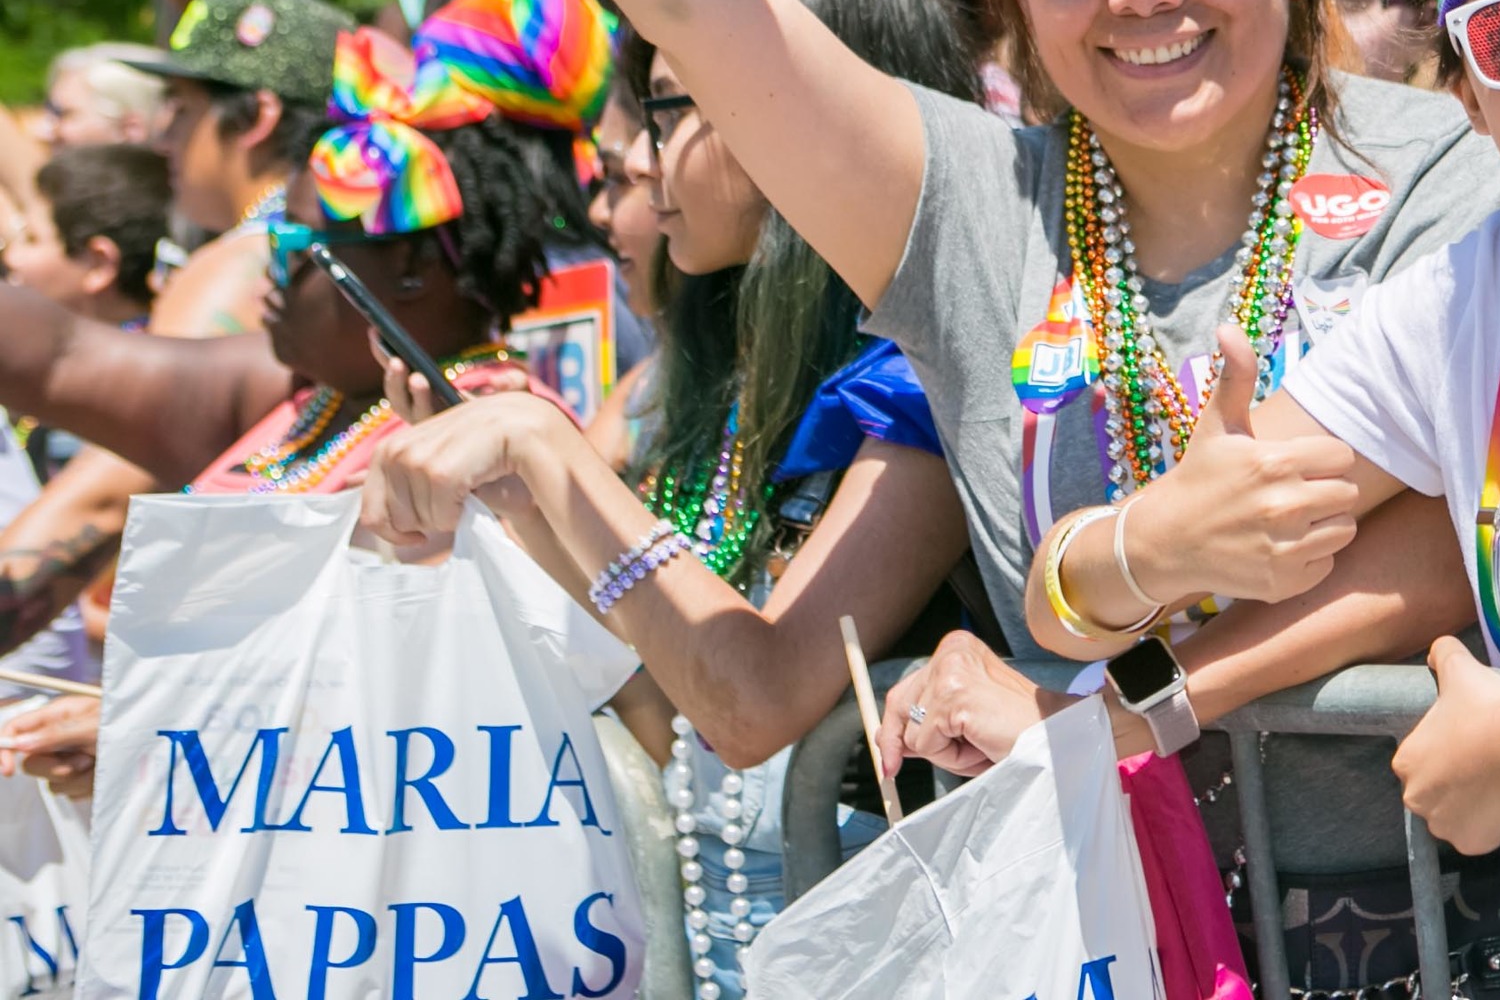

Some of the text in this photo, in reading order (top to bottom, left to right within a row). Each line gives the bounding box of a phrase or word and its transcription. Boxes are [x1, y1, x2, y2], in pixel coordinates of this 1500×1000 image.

[1293, 189, 1391, 217] UGO
[148, 725, 613, 836] MARIA
[130, 892, 627, 1000] PAPPAS
